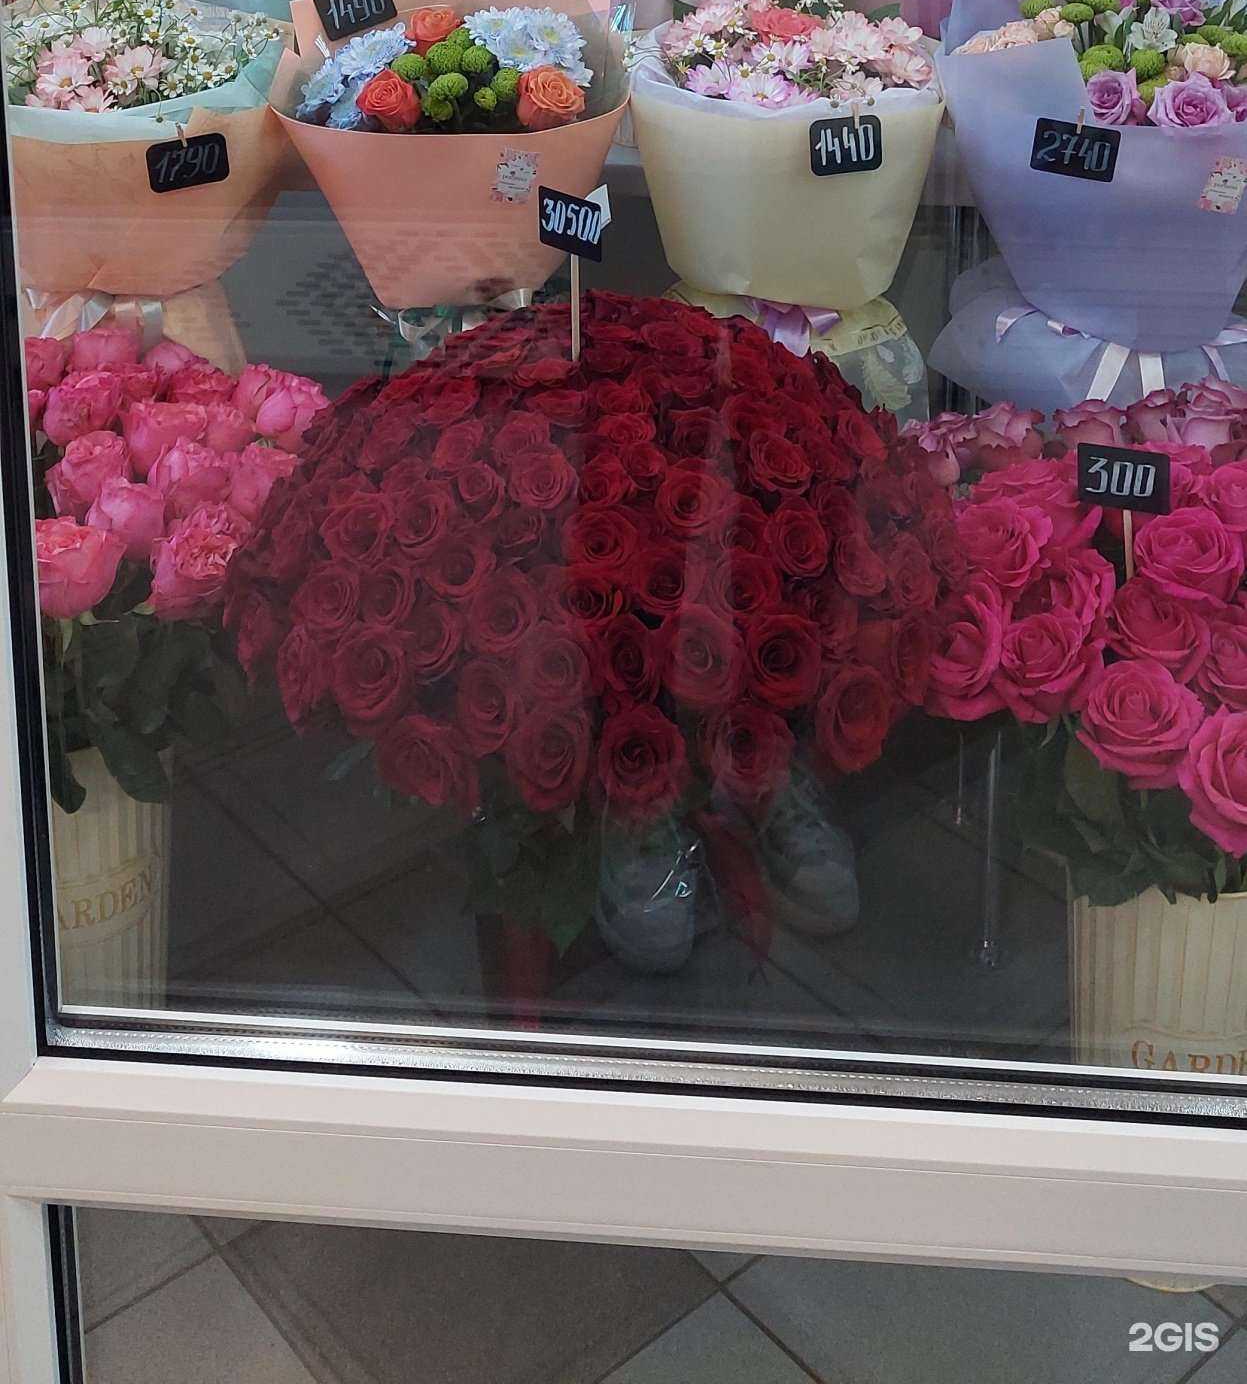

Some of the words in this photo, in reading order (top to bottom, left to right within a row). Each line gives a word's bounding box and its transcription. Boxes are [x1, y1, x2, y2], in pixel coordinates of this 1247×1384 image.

[156, 144, 217, 183] 1790
[814, 124, 874, 166] 1440
[1036, 130, 1111, 170] 2740
[541, 198, 601, 245] 30500
[1085, 456, 1157, 498] 300
